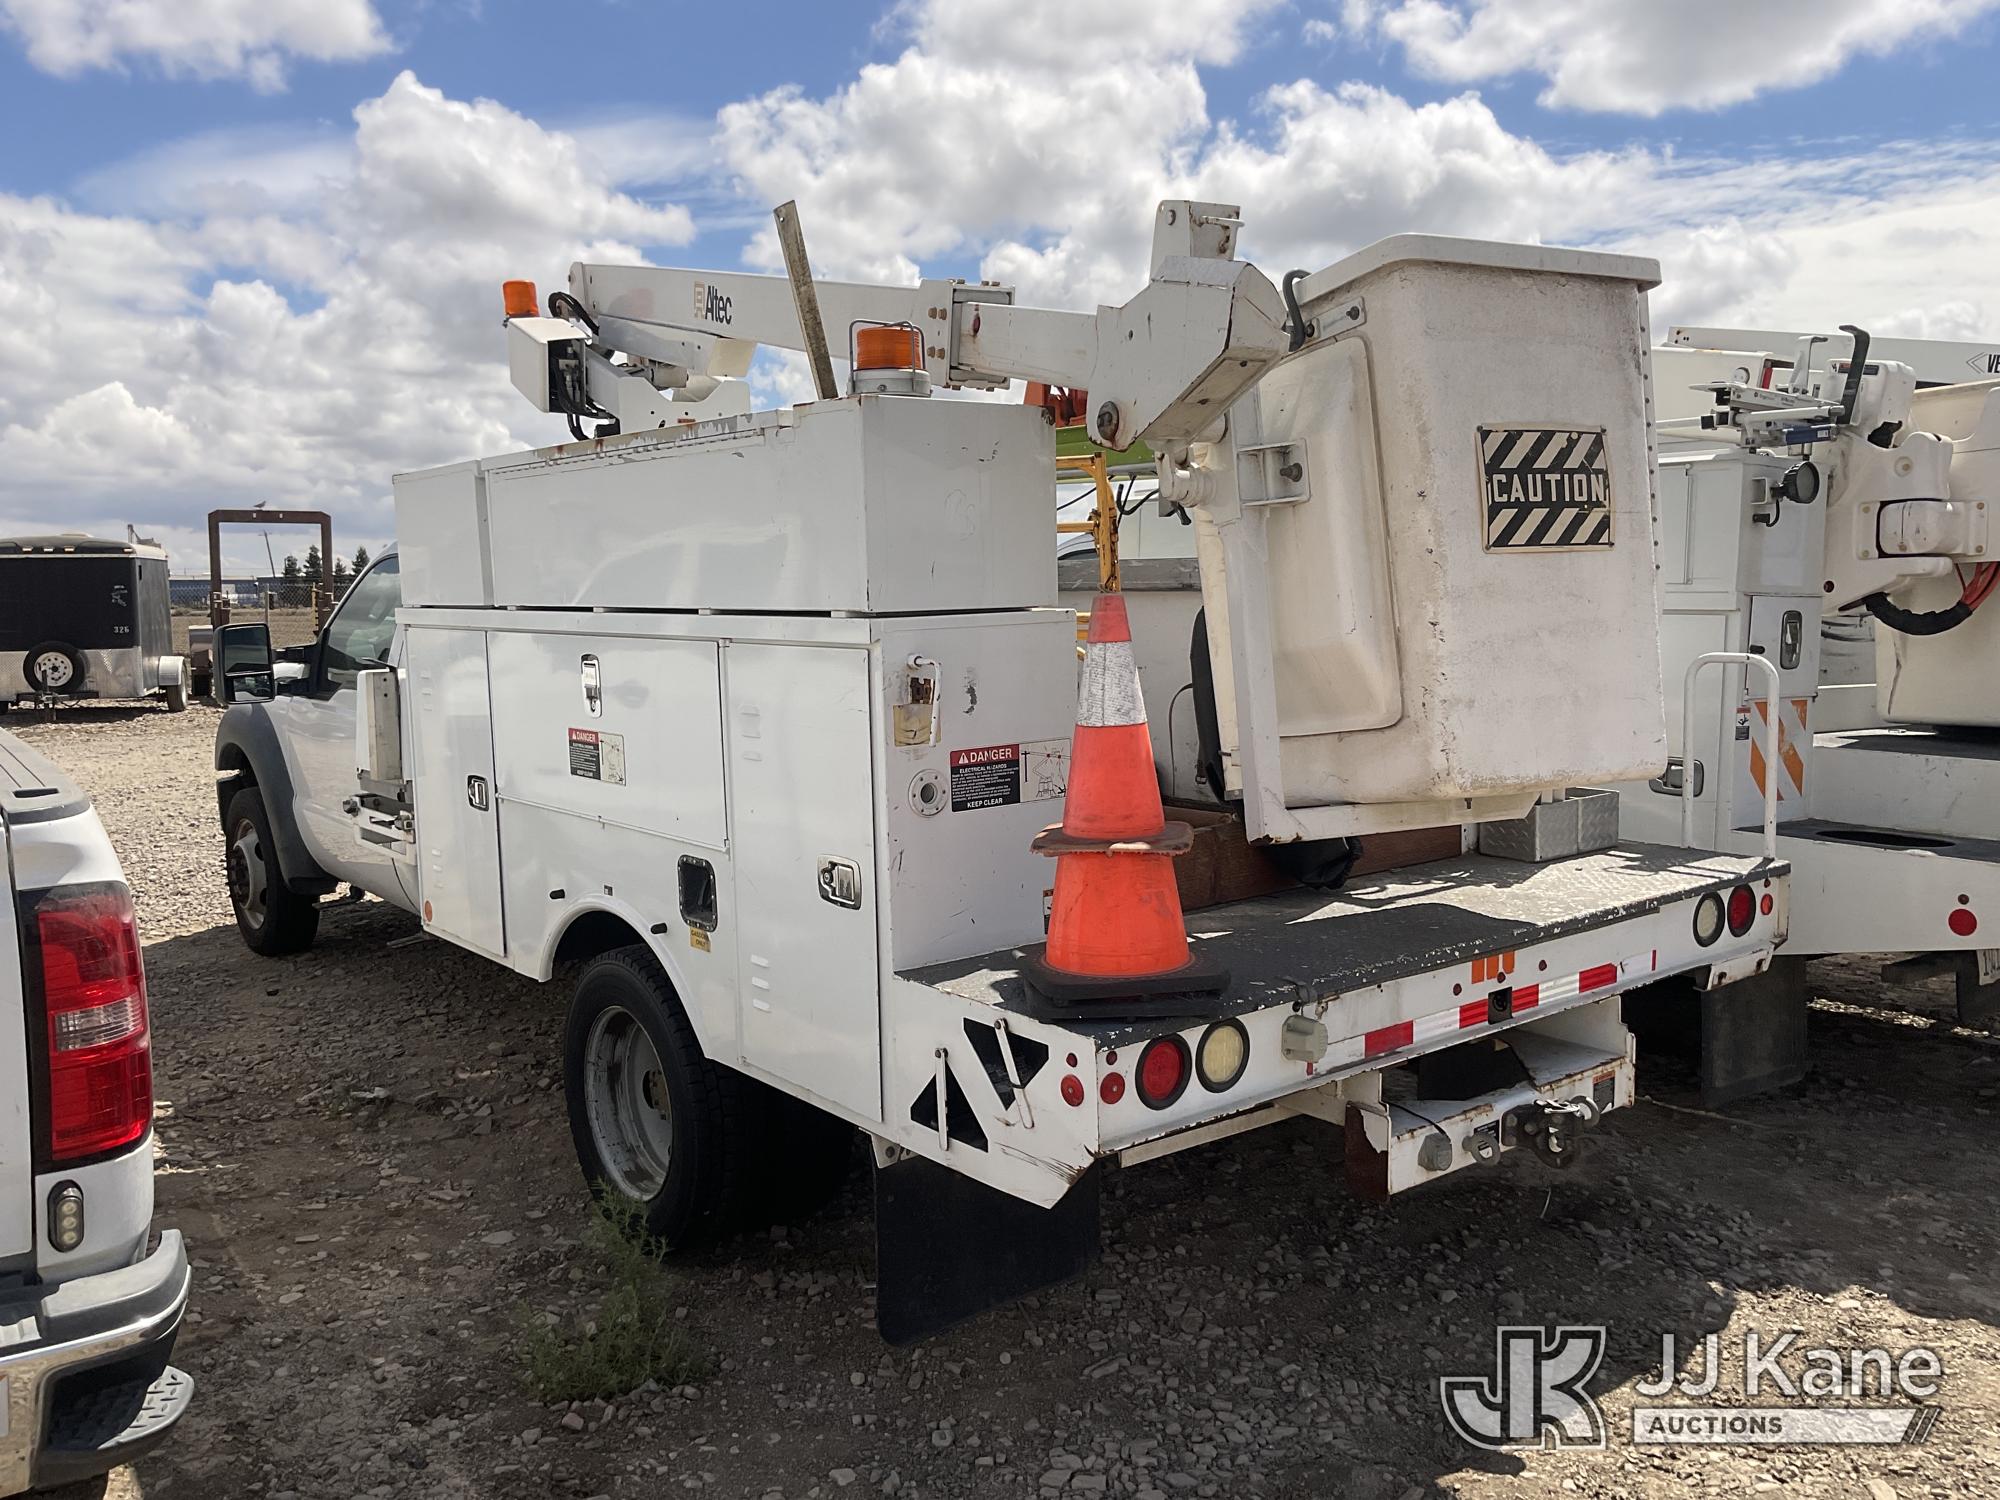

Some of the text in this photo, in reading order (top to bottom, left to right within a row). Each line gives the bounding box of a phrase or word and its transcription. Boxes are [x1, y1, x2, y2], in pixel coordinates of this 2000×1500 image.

[705, 285, 732, 325] Altec
[1492, 474, 1606, 502] CAUTION
[577, 731, 596, 743] DANGER
[970, 748, 1012, 763] DANGER
[960, 766, 986, 774] ELECTRICAL
[967, 797, 1003, 808] KEEP CLEAR
